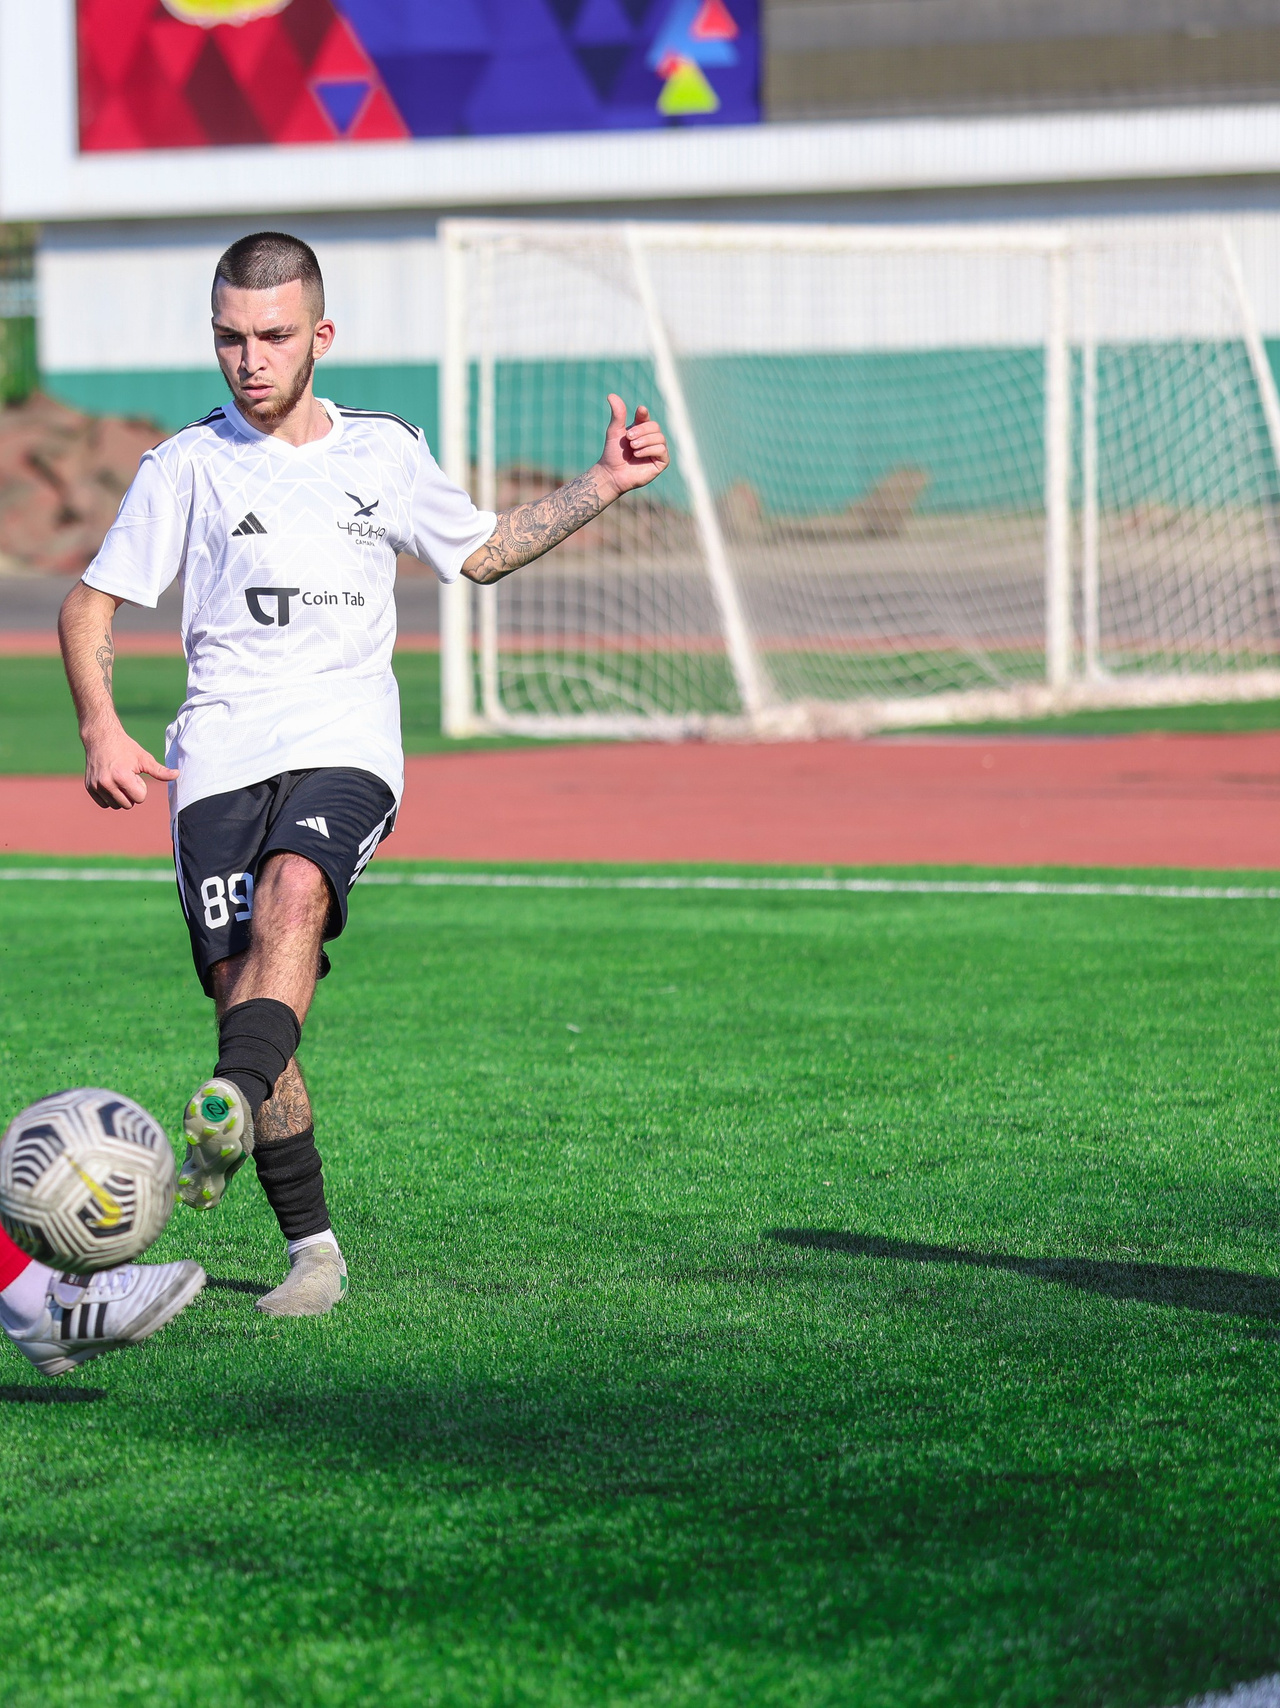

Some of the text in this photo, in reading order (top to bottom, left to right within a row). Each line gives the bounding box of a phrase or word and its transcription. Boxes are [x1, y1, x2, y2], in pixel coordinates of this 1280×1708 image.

[336, 520, 386, 541] ЧАЙКА
[301, 590, 338, 606] Coin
[342, 591, 365, 607] Tab
[200, 871, 255, 930] 89
